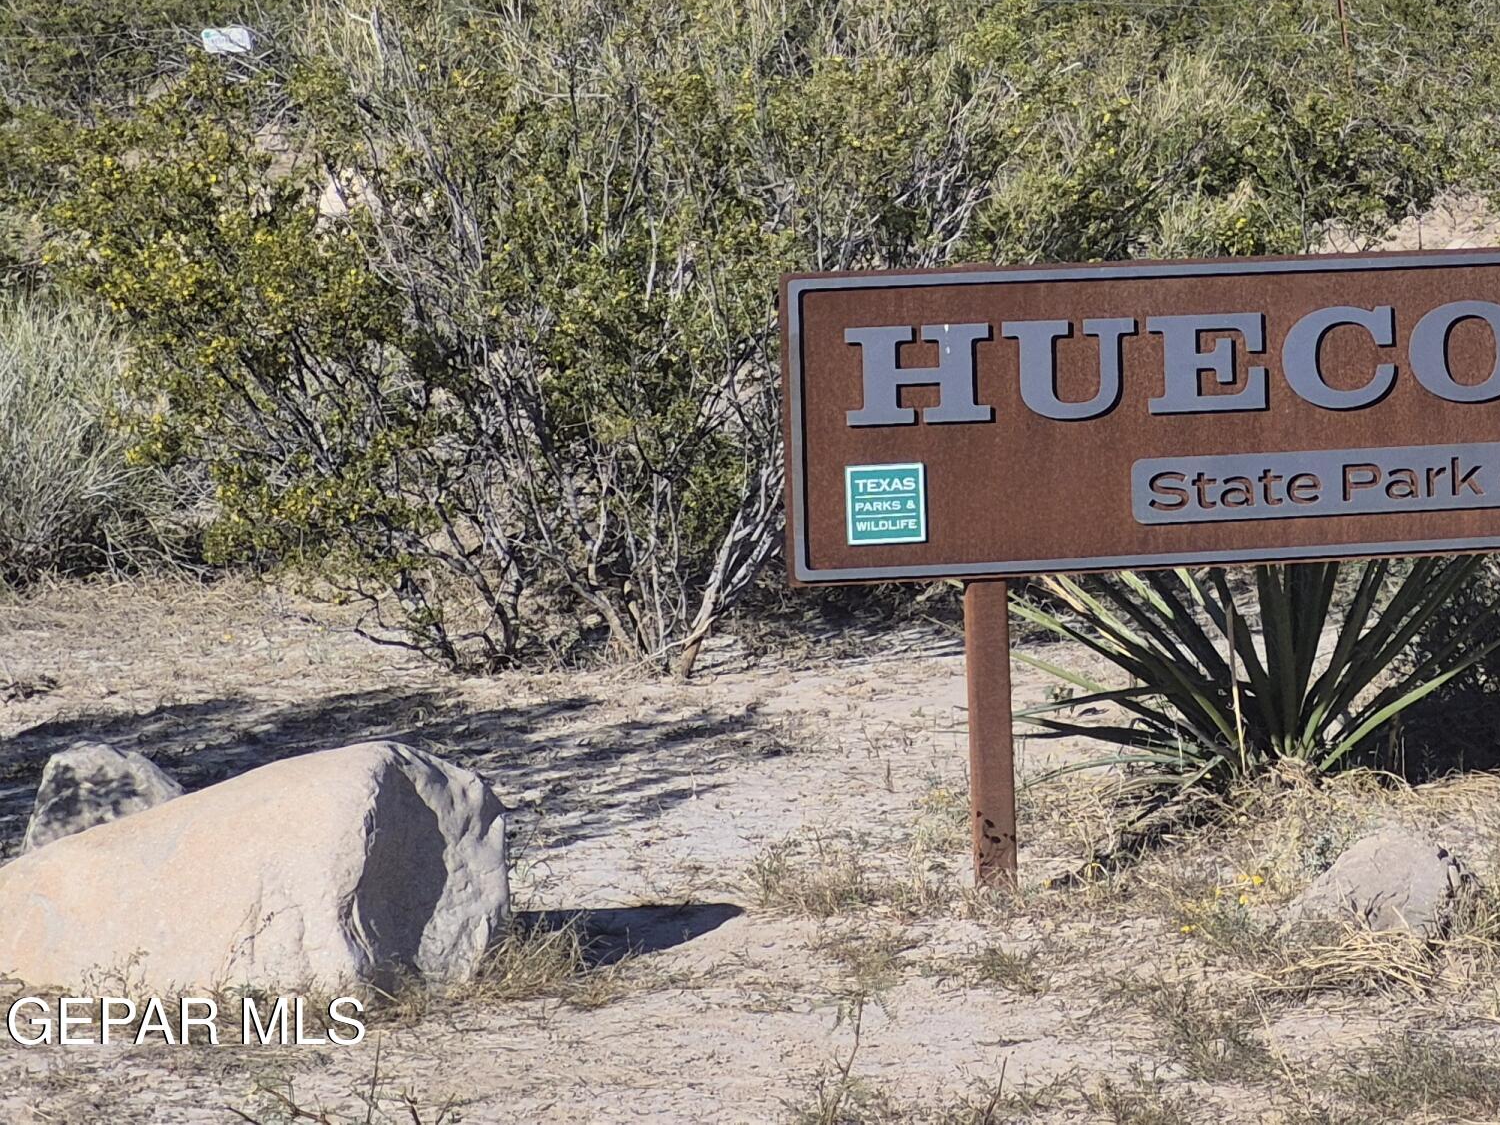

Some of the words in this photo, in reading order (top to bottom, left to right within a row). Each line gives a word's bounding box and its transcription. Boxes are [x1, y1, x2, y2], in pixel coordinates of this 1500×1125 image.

[854, 477, 916, 492] TEXAS
[1147, 465, 1322, 512] State
[1341, 456, 1485, 503] Park
[855, 500, 901, 512] PARKS
[905, 499, 916, 509] &
[856, 519, 917, 531] WILDLIFE
